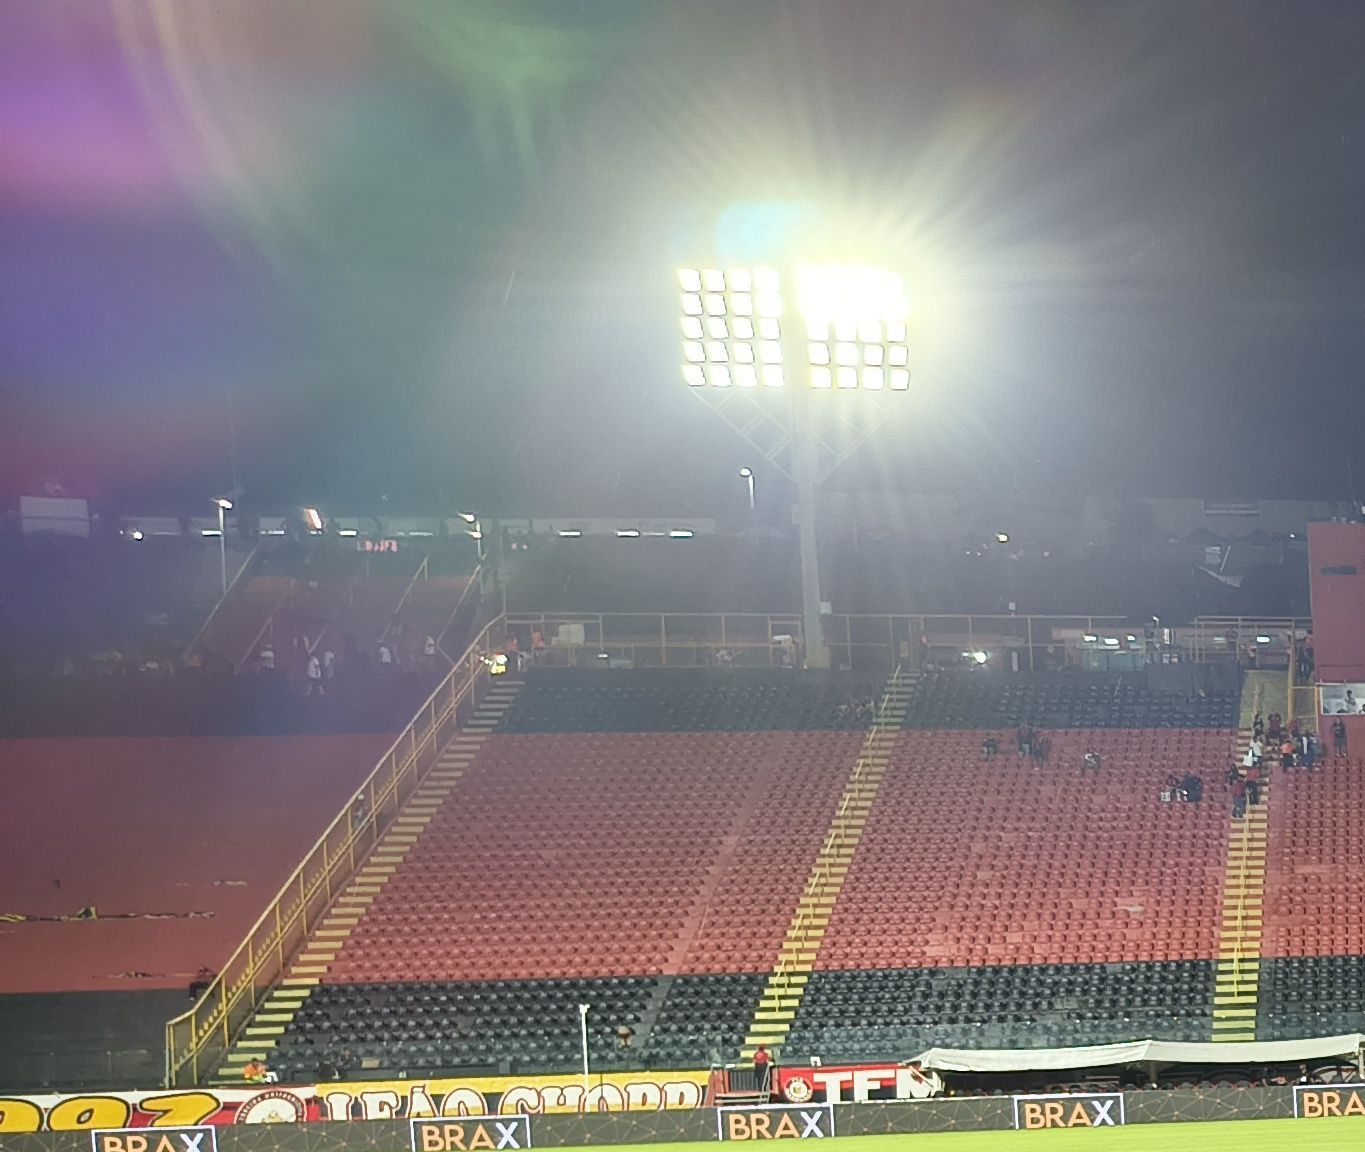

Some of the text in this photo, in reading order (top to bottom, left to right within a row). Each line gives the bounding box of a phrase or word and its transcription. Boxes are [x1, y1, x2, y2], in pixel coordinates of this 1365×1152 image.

[729, 1110, 824, 1141] BRAX
[1025, 1099, 1115, 1130] BRAX
[421, 1121, 520, 1152] BRAX
